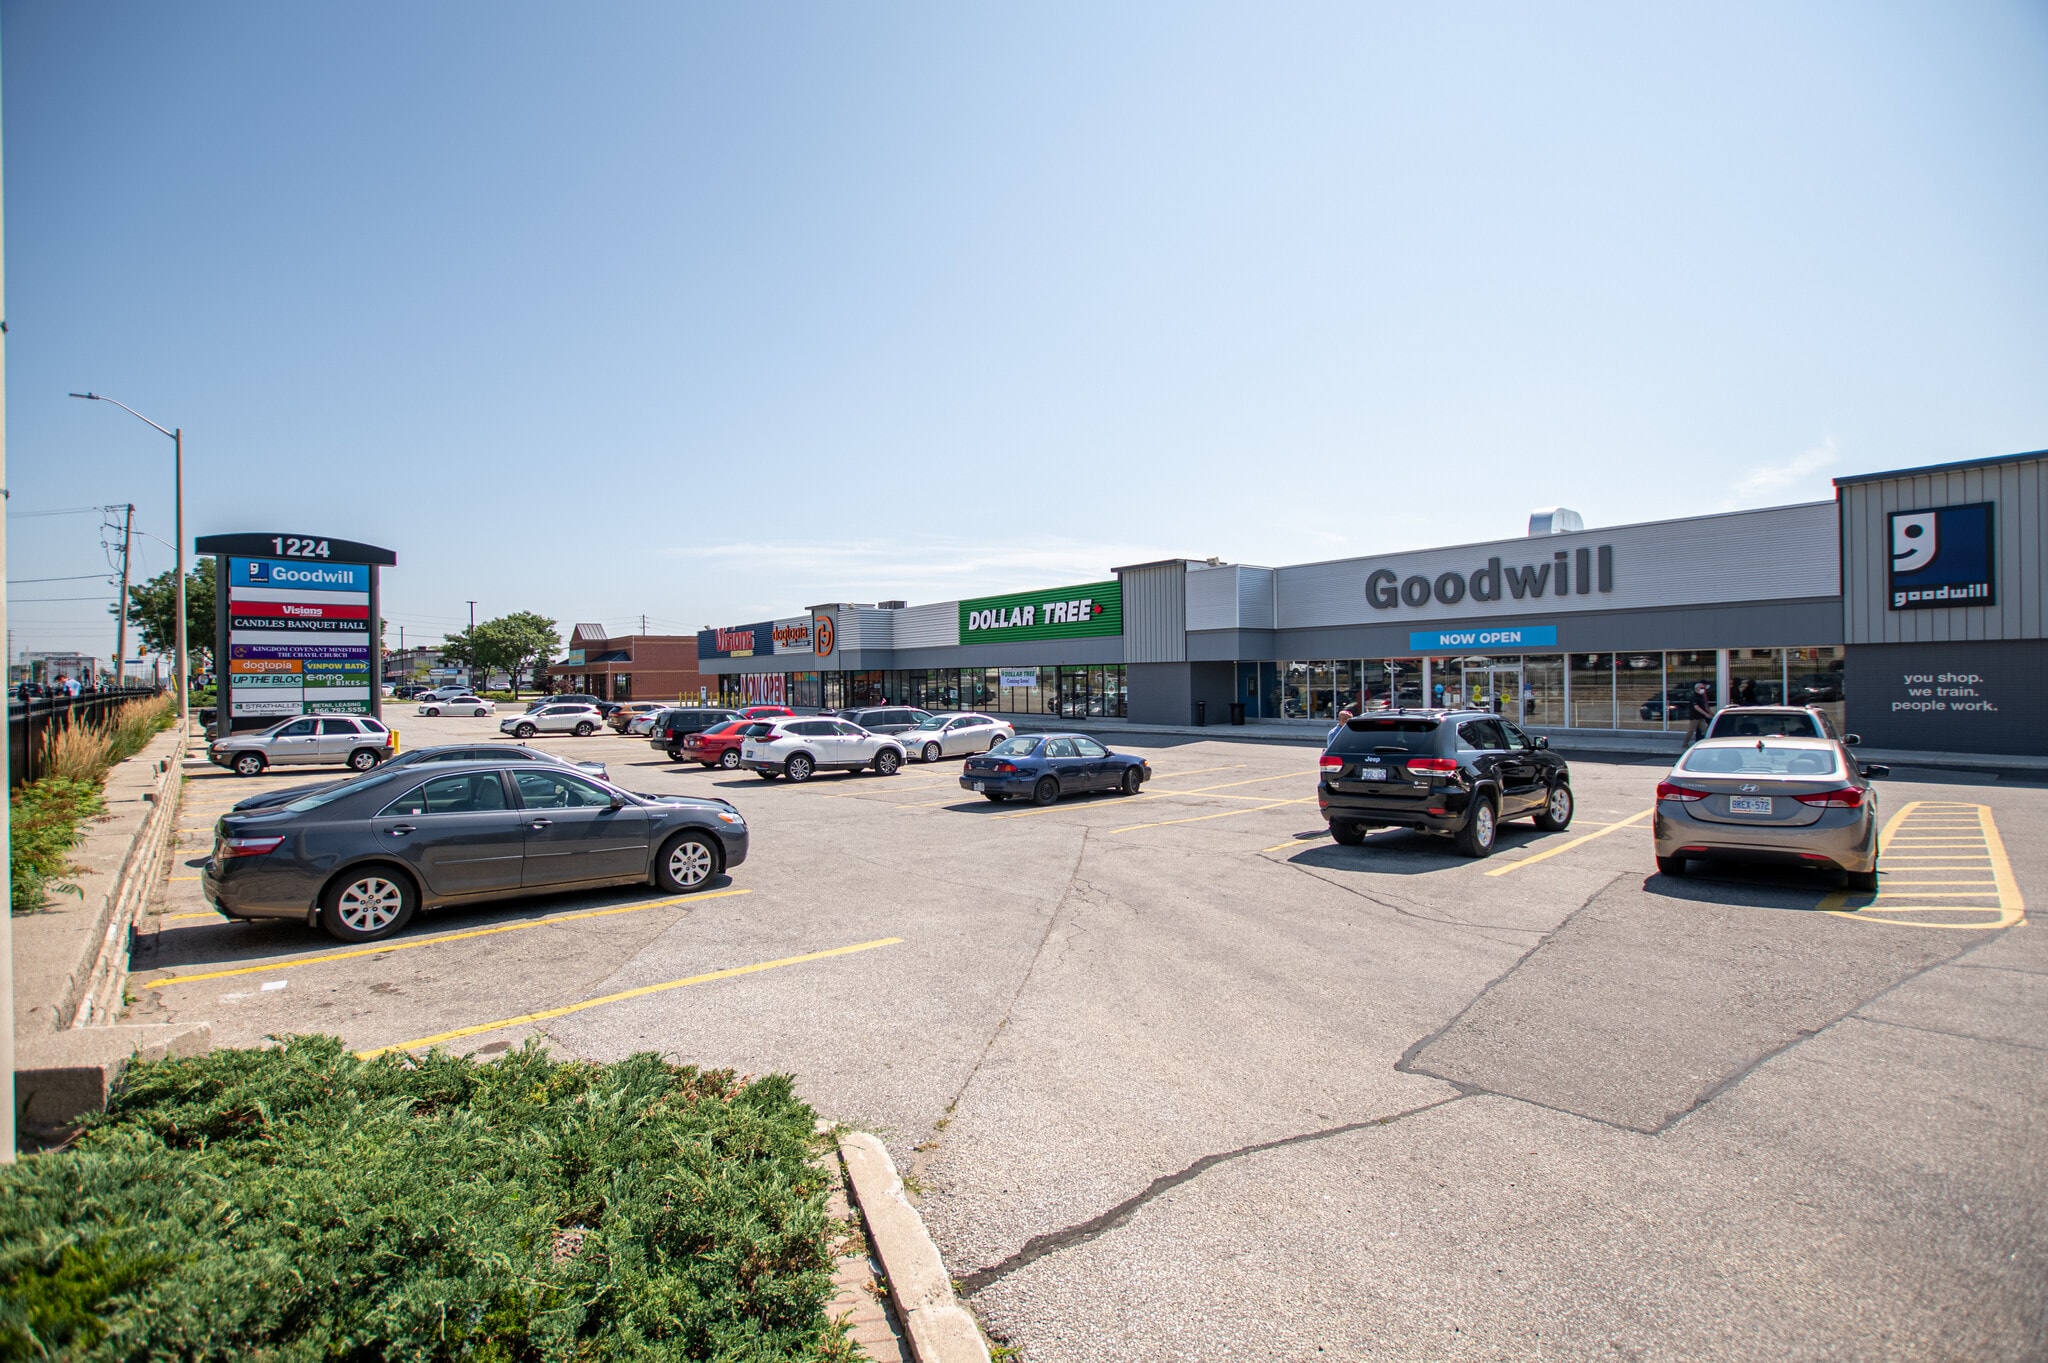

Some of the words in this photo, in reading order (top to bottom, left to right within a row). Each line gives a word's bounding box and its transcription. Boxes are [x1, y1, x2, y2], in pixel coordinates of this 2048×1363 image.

[272, 537, 330, 558] 1224
[272, 567, 353, 584] Goodwill
[1365, 545, 1612, 610] Goodwill
[1894, 583, 1989, 607] goodwill
[282, 606, 322, 614] Visions
[968, 605, 1035, 630] DOLLAR
[1042, 599, 1092, 624] TREE
[235, 618, 285, 628] CANDLES
[288, 620, 337, 630] BANQUET
[340, 622, 366, 630] HALL
[715, 627, 754, 652] Visions
[772, 624, 808, 648] dogtopia
[1440, 633, 1476, 646] NOW
[1479, 632, 1521, 644] OPEN
[242, 660, 292, 672] dogtopia
[233, 676, 248, 684] UP
[250, 676, 271, 684] THE
[272, 676, 302, 684] BLOC
[1904, 674, 1934, 684] you
[1937, 672, 1984, 683] shop.
[763, 675, 786, 702] OPEN
[1908, 688, 1932, 696] we
[1936, 686, 1979, 696] train.
[1892, 700, 1946, 712] people
[1950, 700, 1998, 711] work.
